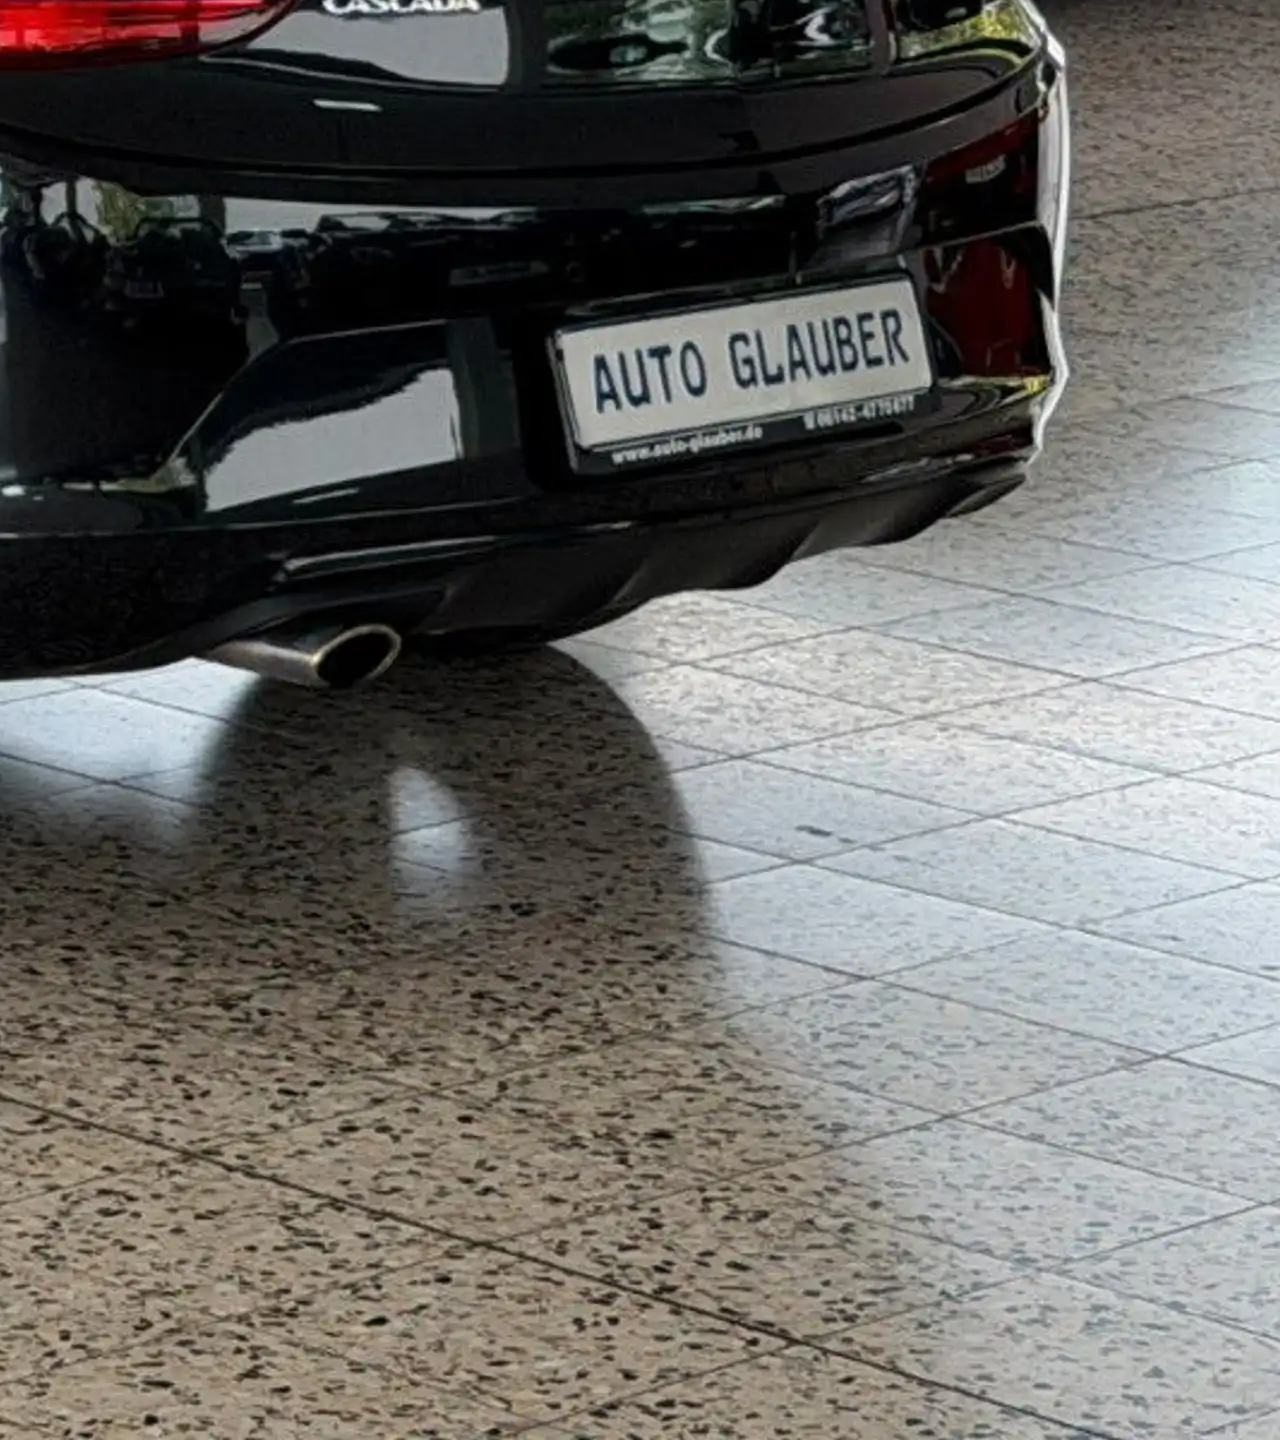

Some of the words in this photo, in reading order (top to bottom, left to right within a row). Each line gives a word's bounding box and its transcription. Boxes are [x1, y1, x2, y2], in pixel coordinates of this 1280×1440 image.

[593, 340, 708, 414] AUTO
[728, 308, 911, 390] GLAUBER
[611, 424, 764, 465] www.auto-glauber.de
